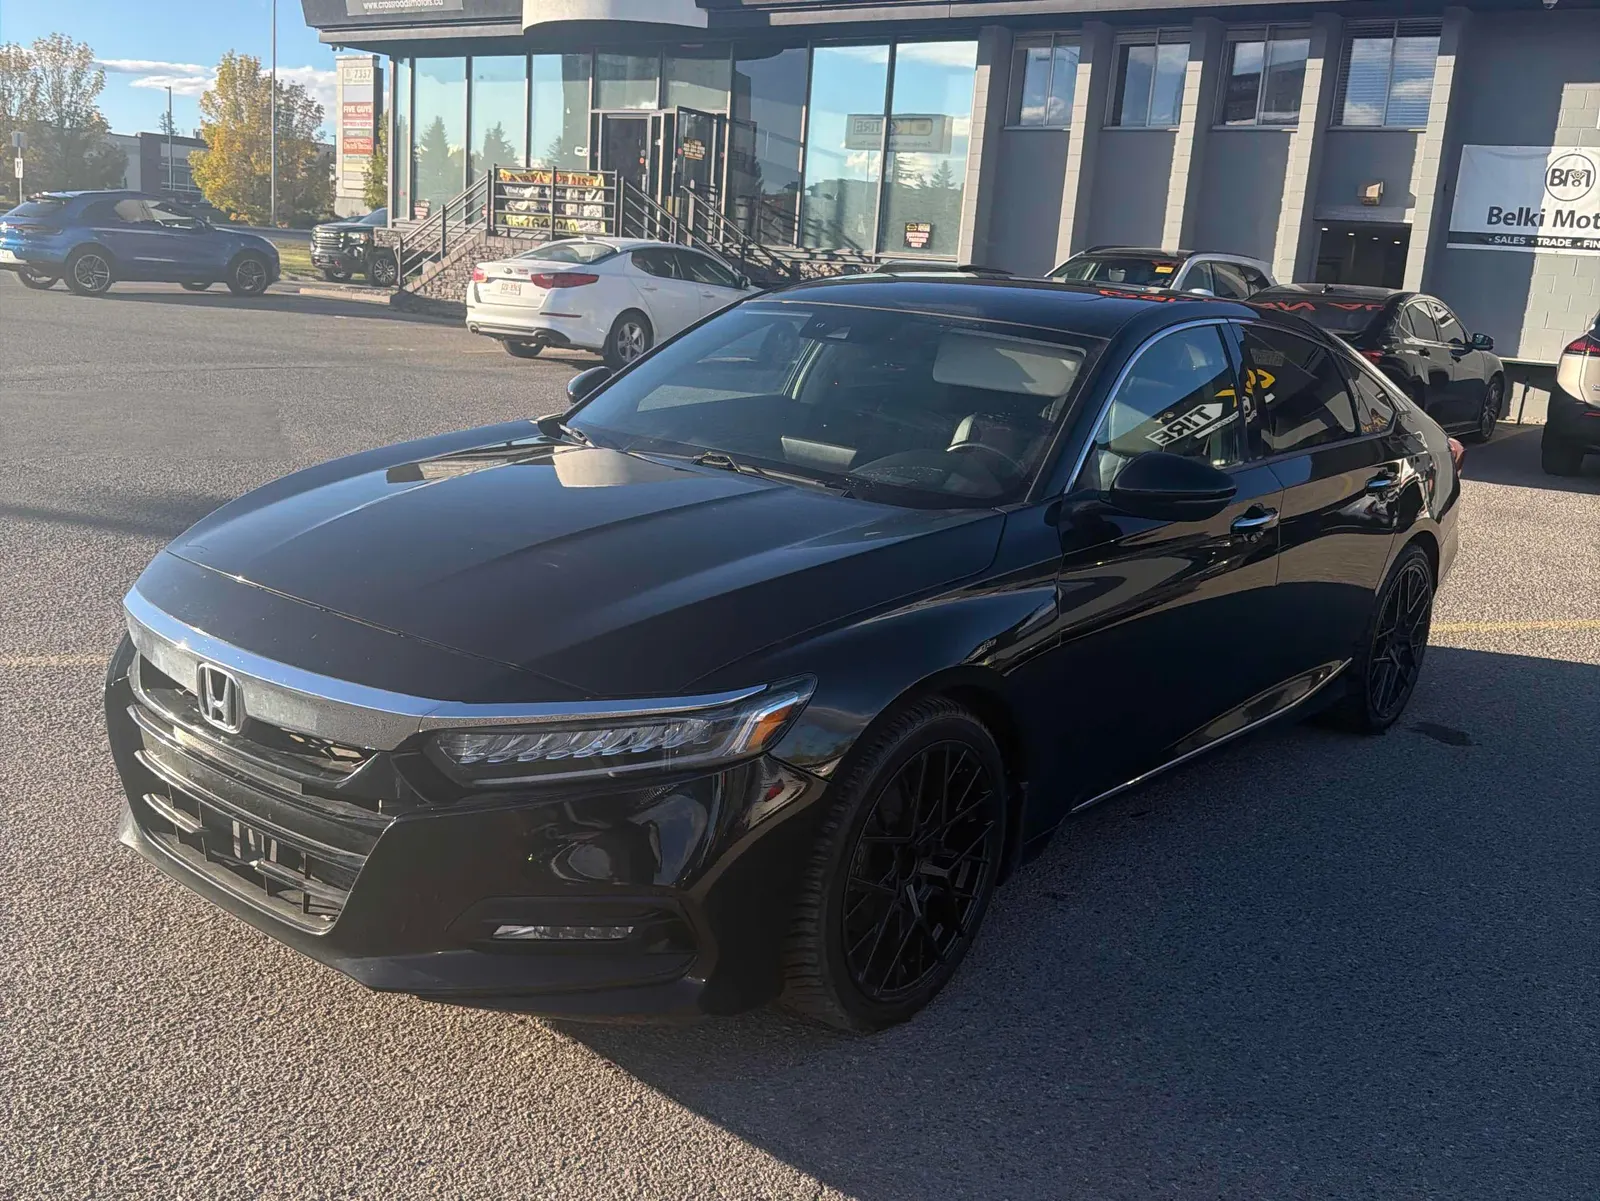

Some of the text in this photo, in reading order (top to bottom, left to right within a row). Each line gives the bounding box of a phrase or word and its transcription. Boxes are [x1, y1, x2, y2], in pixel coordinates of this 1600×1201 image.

[1487, 206, 1600, 230] Belki Mot
[1494, 235, 1526, 245] SALES
[1537, 237, 1573, 248] TRADE
